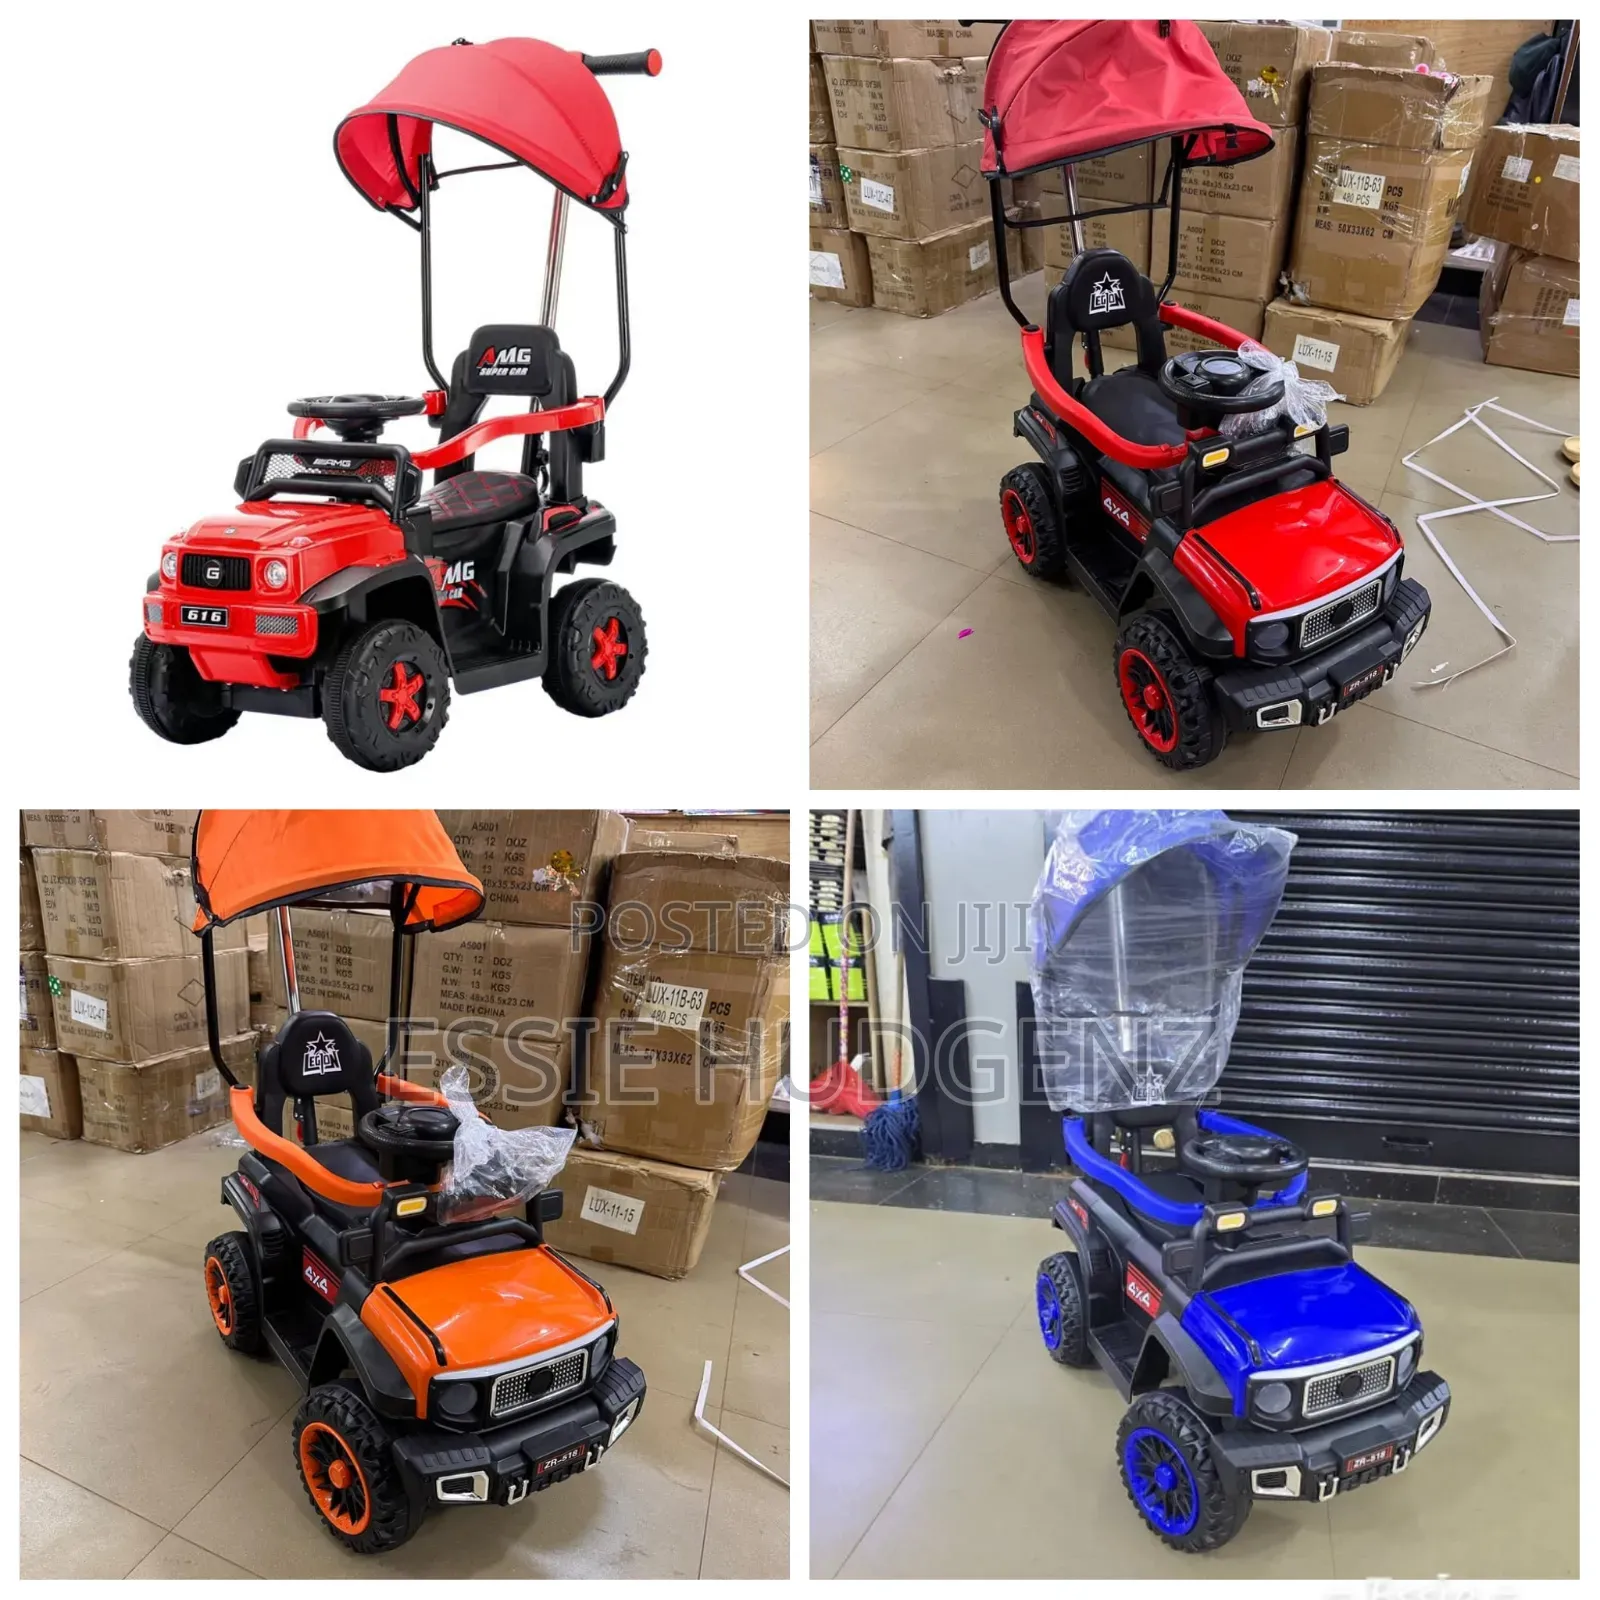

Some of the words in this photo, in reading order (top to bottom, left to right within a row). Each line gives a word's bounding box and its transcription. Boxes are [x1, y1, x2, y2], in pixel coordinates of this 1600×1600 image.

[1218, 172, 1234, 180] KGS
[1208, 191, 1231, 199] CHINA
[1386, 186, 1404, 197] PCS
[1342, 192, 1354, 203] 480
[1356, 194, 1370, 206] PCS
[1383, 200, 1399, 211] KGS
[1338, 223, 1375, 237] 50X33X62
[1382, 230, 1394, 239] CM
[1211, 239, 1226, 247] DOZ
[1209, 258, 1224, 266] KGS
[1201, 274, 1222, 283] CHINA
[1089, 291, 1126, 315] LEGION
[476, 345, 531, 368] AMG
[1298, 343, 1333, 363] LUX-11-15
[479, 367, 509, 376] SUPER
[509, 367, 529, 376] CAR
[206, 567, 220, 579] G
[449, 588, 463, 599] CAR
[187, 610, 222, 622] 616
[154, 822, 175, 834] MADE
[472, 822, 499, 832] A5001
[486, 837, 496, 846] 12
[506, 838, 528, 847] DOZ
[484, 851, 494, 860] 14
[504, 852, 526, 862] KGS
[482, 865, 492, 874] 13
[503, 866, 525, 876] KGS
[534, 882, 550, 892] CM
[489, 893, 519, 904] CHINA
[307, 929, 330, 939] A5001
[320, 943, 328, 951] 12
[336, 945, 352, 955] DOZ
[460, 941, 487, 951] A5001
[320, 955, 328, 963] 14
[336, 956, 353, 967] KGS
[443, 952, 464, 962] QTY:
[473, 956, 484, 964] 12
[493, 957, 513, 967] DOZ
[319, 966, 328, 974] 13
[336, 968, 353, 978] KGS
[442, 965, 462, 974] G.W:
[472, 968, 482, 977] 14
[492, 970, 512, 980] KGS
[361, 984, 374, 992] CM
[441, 977, 461, 986] N.W:
[471, 981, 480, 989] 13
[491, 983, 511, 993] KGS
[317, 989, 326, 997] IN
[327, 991, 352, 1001] CHINA
[440, 989, 467, 1000] MEAS:
[470, 993, 518, 1007] 48x35.5x23
[519, 999, 535, 1008] CM
[646, 985, 704, 1011] LUX-11B-63
[440, 1001, 464, 1012] MADE
[477, 1007, 506, 1017] CHINA
[709, 1001, 732, 1016] PCS
[651, 1009, 666, 1023] 480
[668, 1012, 688, 1026] PCS
[303, 1050, 342, 1076] LEGION
[643, 1048, 693, 1066] 50X33X62
[702, 1055, 717, 1068] CM
[505, 1105, 519, 1113] CM
[589, 1197, 635, 1223] LUX-11-15
[544, 1451, 578, 1469] ZR-518
[1353, 1451, 1387, 1469] ZR-518
